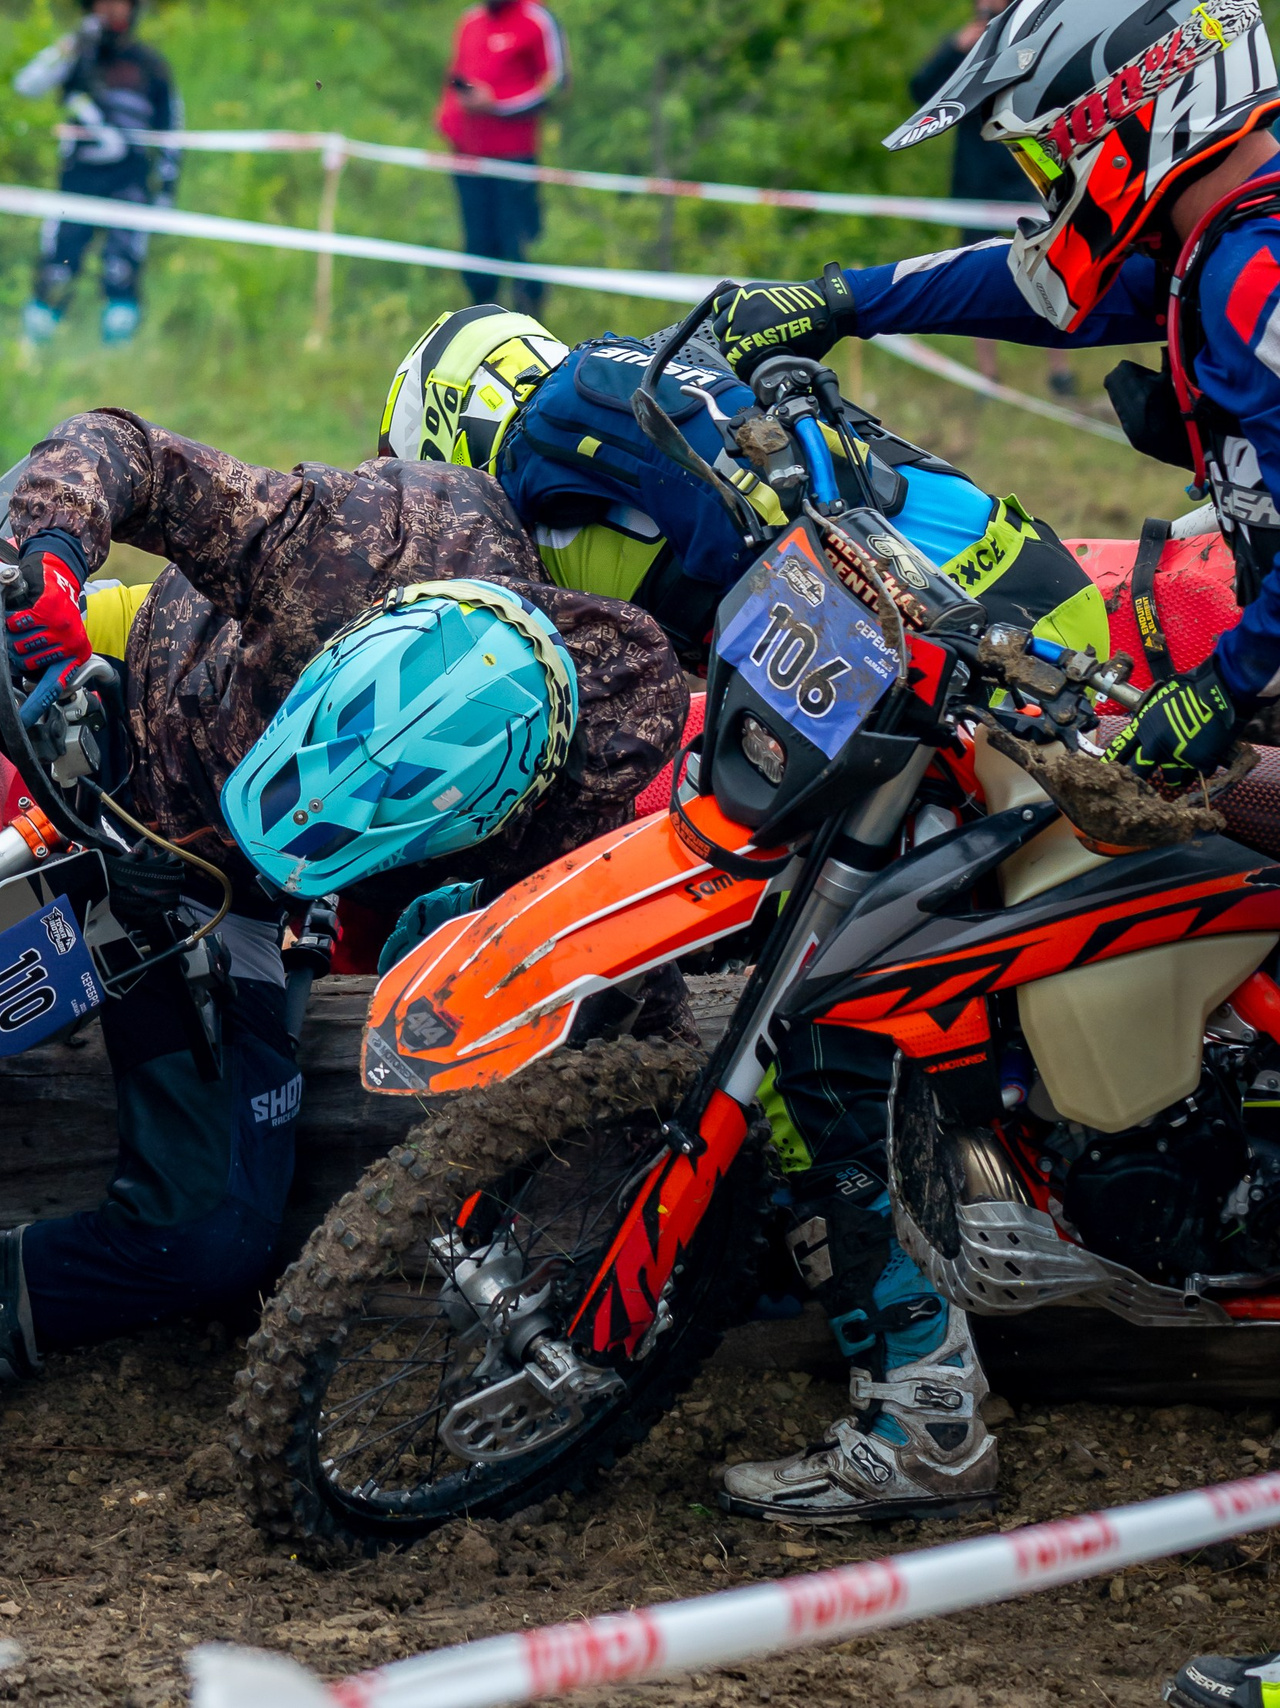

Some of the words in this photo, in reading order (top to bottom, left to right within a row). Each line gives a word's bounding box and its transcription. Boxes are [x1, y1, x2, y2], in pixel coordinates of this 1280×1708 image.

[739, 316, 814, 353] FASTER
[749, 602, 853, 719] 106
[1100, 717, 1140, 764] FAST
[366, 846, 407, 877] FOX
[80, 971, 100, 1007] СЕРЕБРО
[937, 1051, 988, 1072] MOTOREX
[250, 1071, 303, 1124] SHOT
[271, 1111, 291, 1127] RACE
[835, 1166, 859, 1182] SG
[835, 1172, 874, 1196] 22
